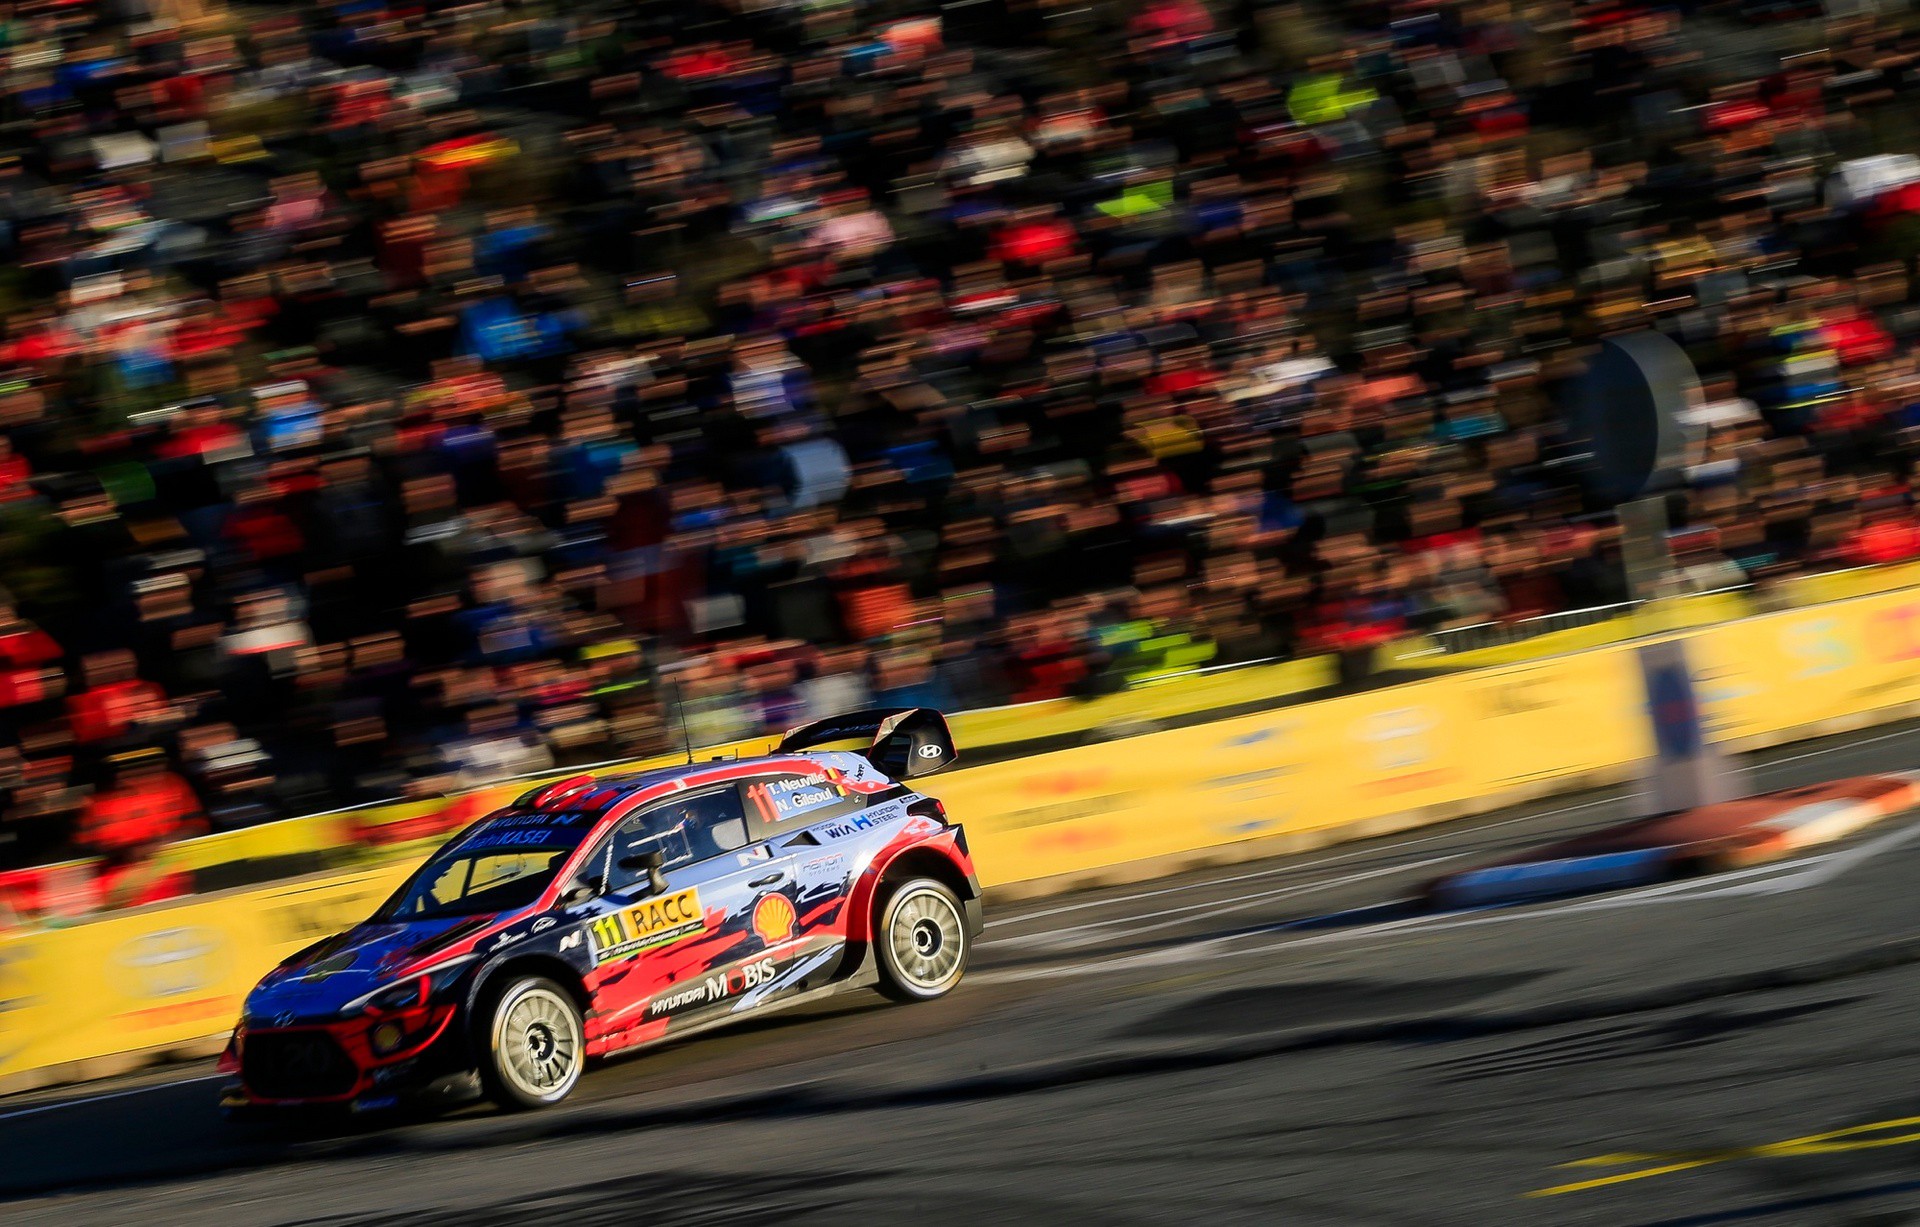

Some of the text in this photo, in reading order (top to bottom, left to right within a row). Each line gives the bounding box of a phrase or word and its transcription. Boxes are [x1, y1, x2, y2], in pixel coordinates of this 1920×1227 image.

[766, 773, 826, 795] T. Neuville
[747, 782, 781, 822] 11
[775, 787, 834, 813] N. Gilsoul
[866, 804, 900, 818] HYUNDAI
[872, 813, 898, 825] STEEL
[593, 914, 622, 948] 11
[631, 894, 693, 934] RACC
[651, 957, 776, 1015] HYUNDAI MOBIS
